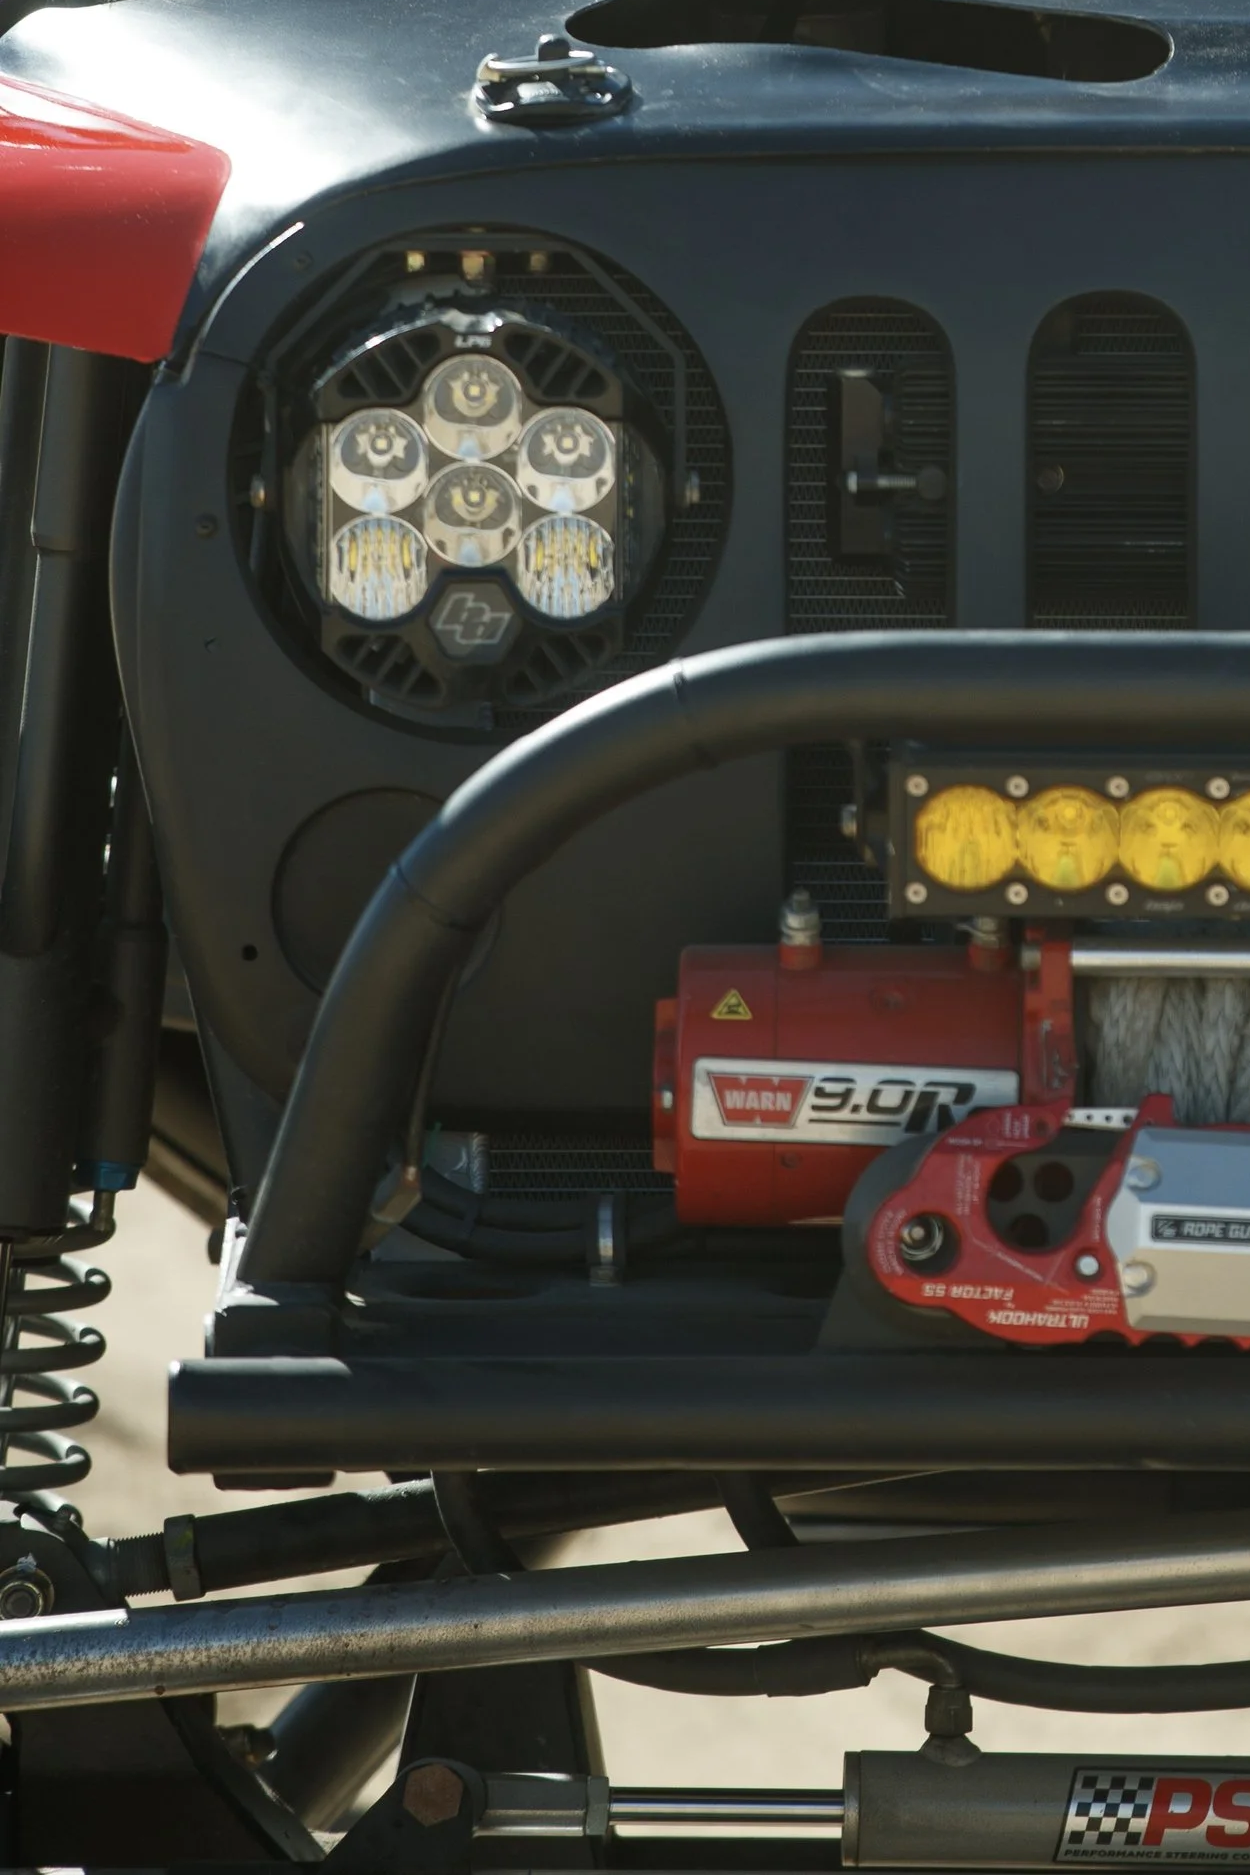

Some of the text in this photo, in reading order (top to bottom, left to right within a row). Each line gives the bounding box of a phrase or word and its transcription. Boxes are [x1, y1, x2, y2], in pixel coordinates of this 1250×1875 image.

[724, 1089, 792, 1112] WARN
[1183, 1220, 1226, 1239] ROPE
[950, 1285, 1015, 1301] FACTOR
[986, 1309, 1089, 1329] ULTRAHOOK
[1063, 1848, 1162, 1860] PERFORMANCE
[1164, 1850, 1230, 1861] STEERING
